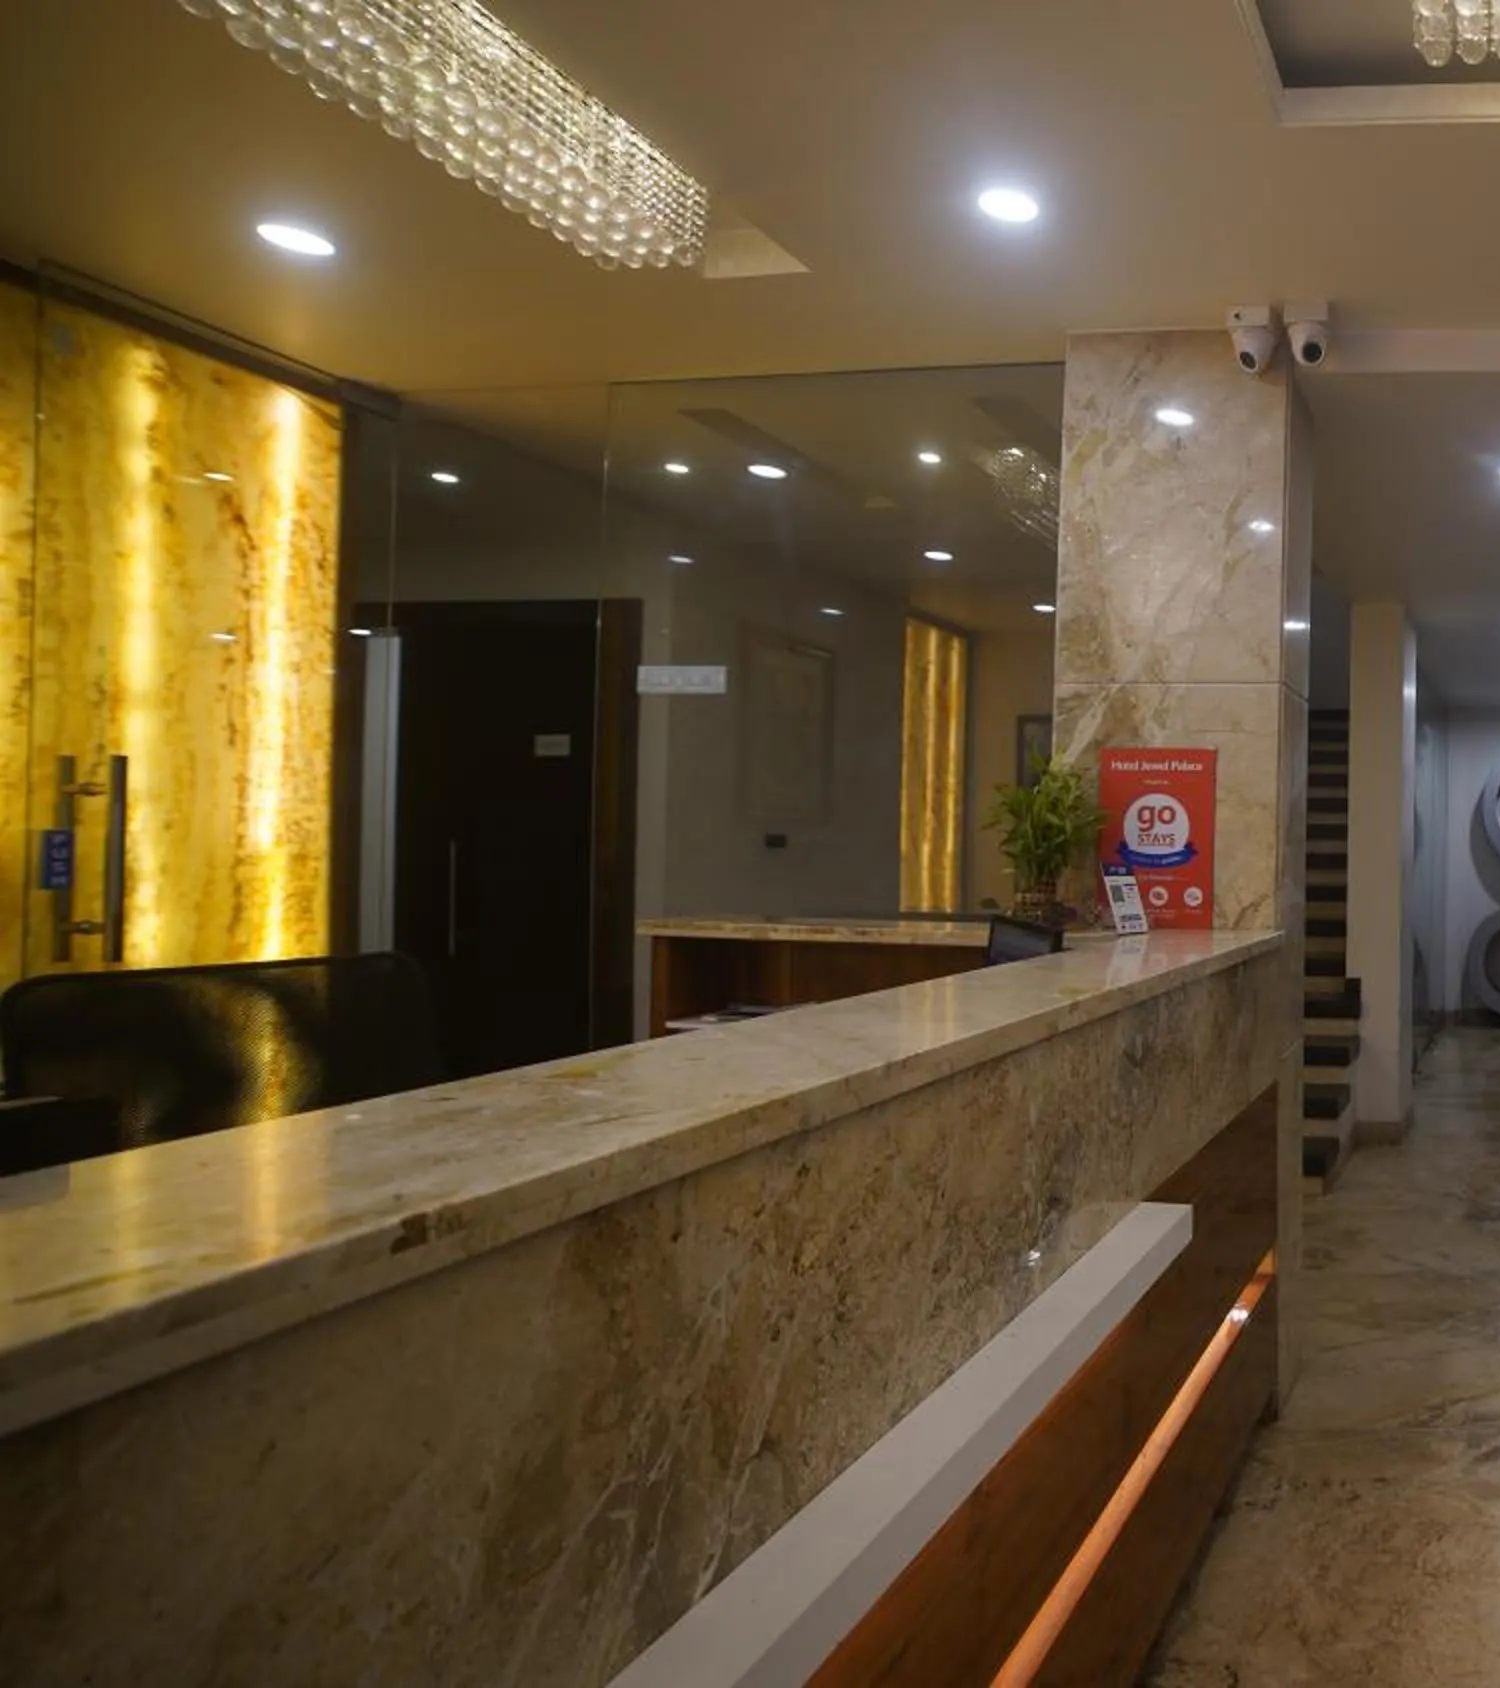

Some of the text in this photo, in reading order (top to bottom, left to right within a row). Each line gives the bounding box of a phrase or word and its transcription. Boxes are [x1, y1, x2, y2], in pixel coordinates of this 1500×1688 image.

[1111, 760, 1203, 772] Hotel Jewel Palace
[1137, 805, 1176, 832] go
[1137, 833, 1176, 845] STAYS
